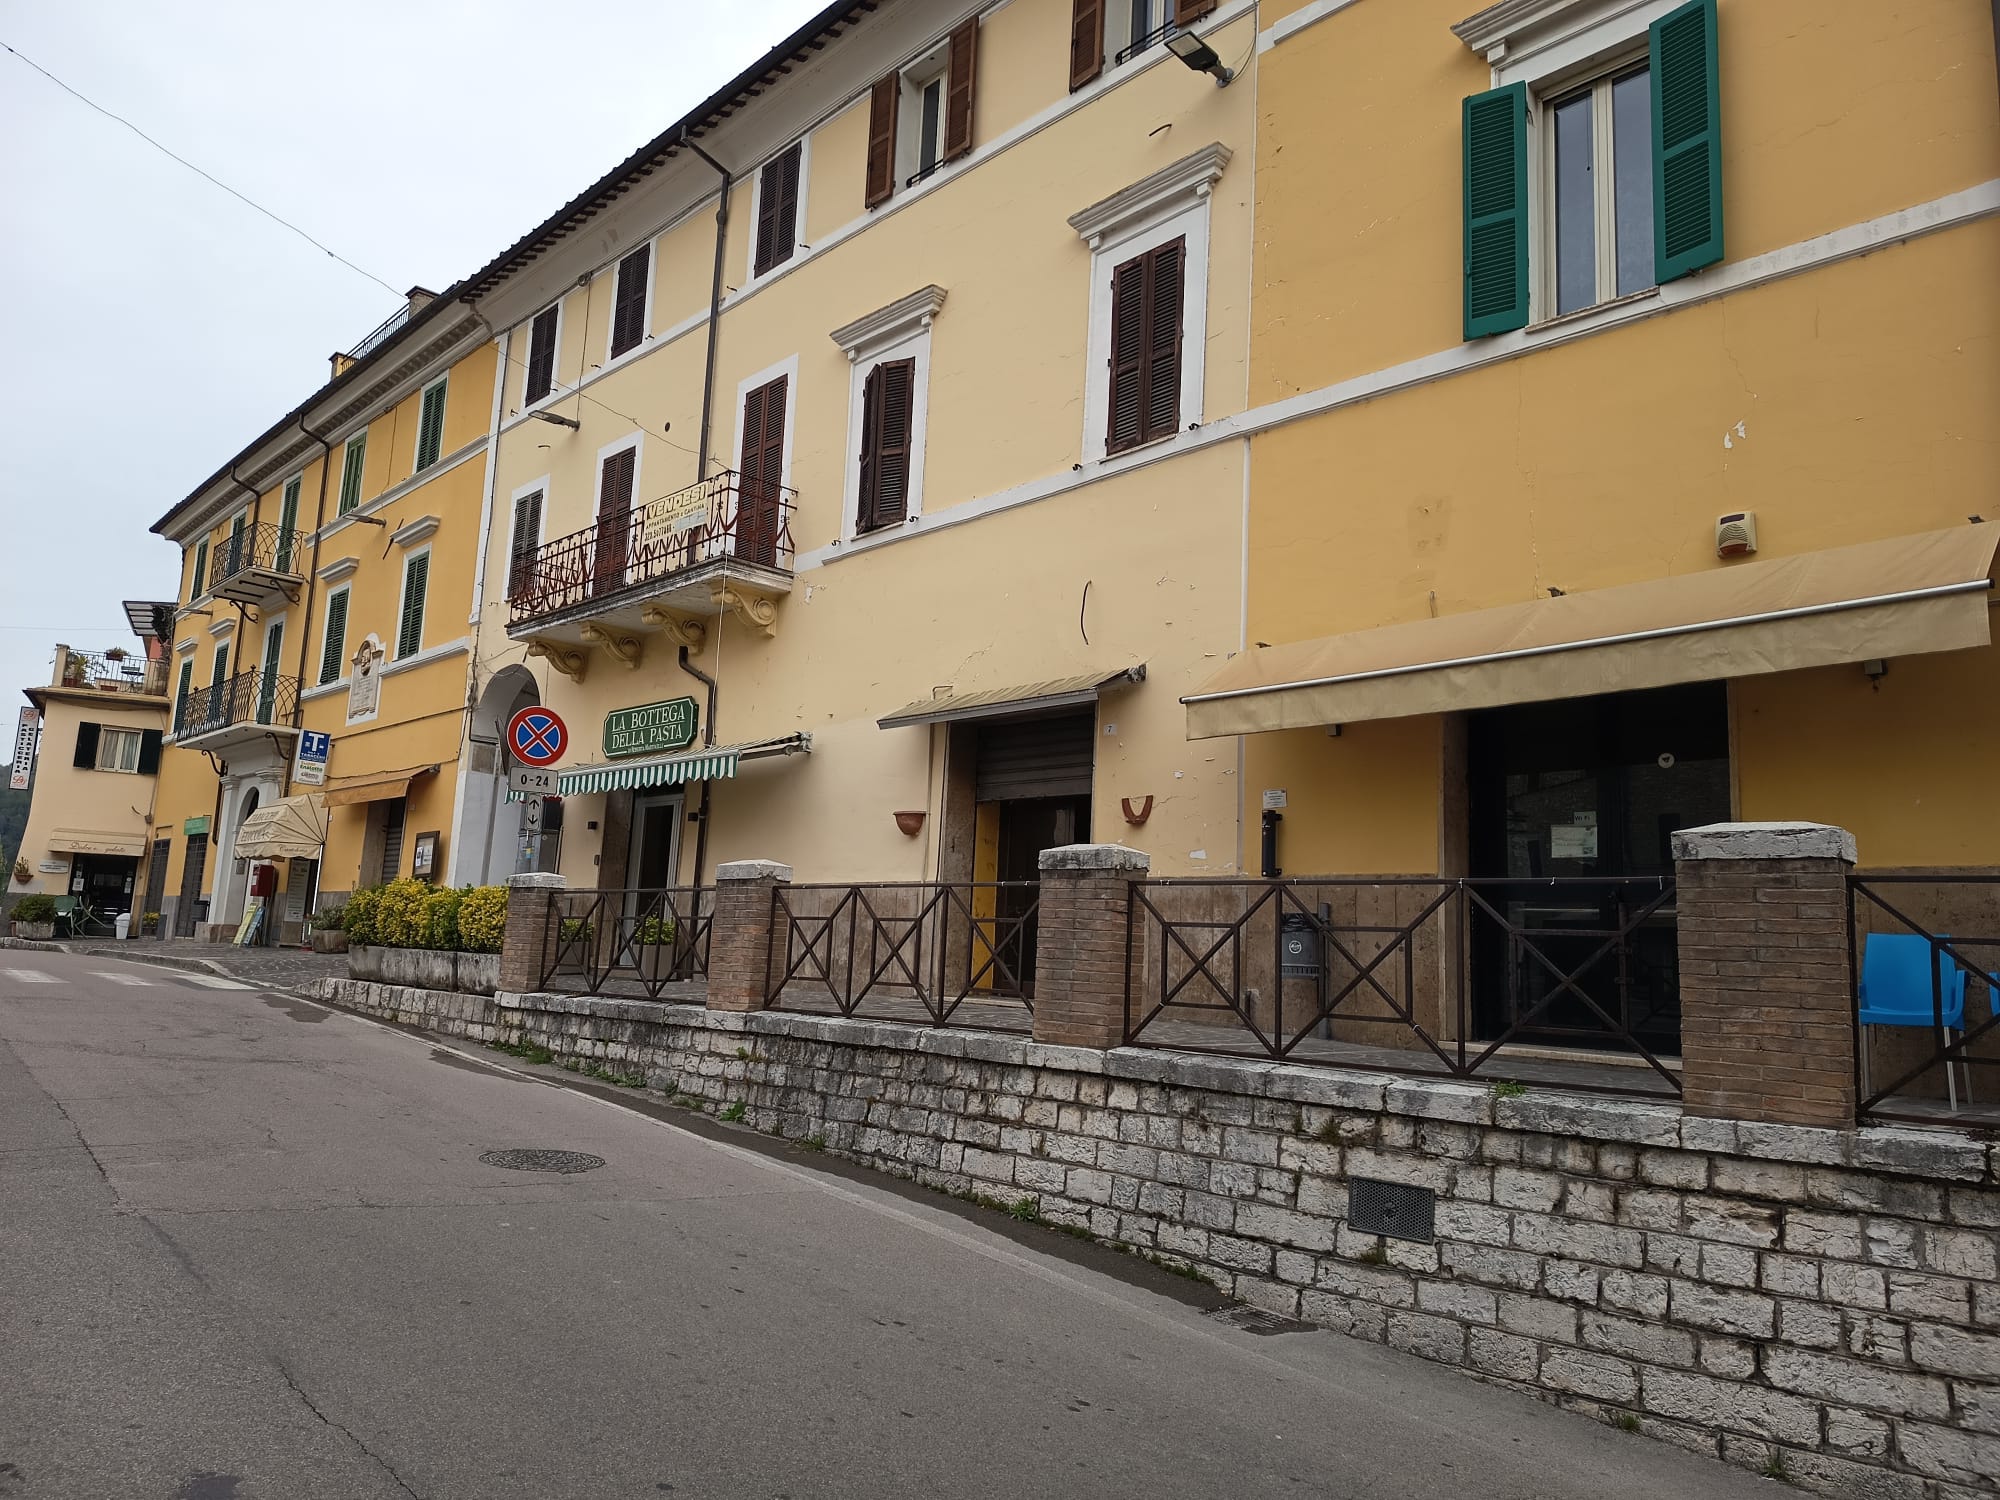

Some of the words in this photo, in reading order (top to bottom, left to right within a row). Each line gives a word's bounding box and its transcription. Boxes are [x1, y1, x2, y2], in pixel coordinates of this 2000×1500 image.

[647, 485, 706, 520] VENDESI
[612, 715, 625, 732] LA
[631, 704, 685, 728] BOTTEGA
[15, 724, 28, 773] PASTICCERIA
[22, 728, 35, 771] GELATERIA
[308, 733, 325, 751] T
[612, 730, 644, 749] DELLA
[649, 724, 682, 743] PASTA
[520, 774, 549, 787] 0-24
